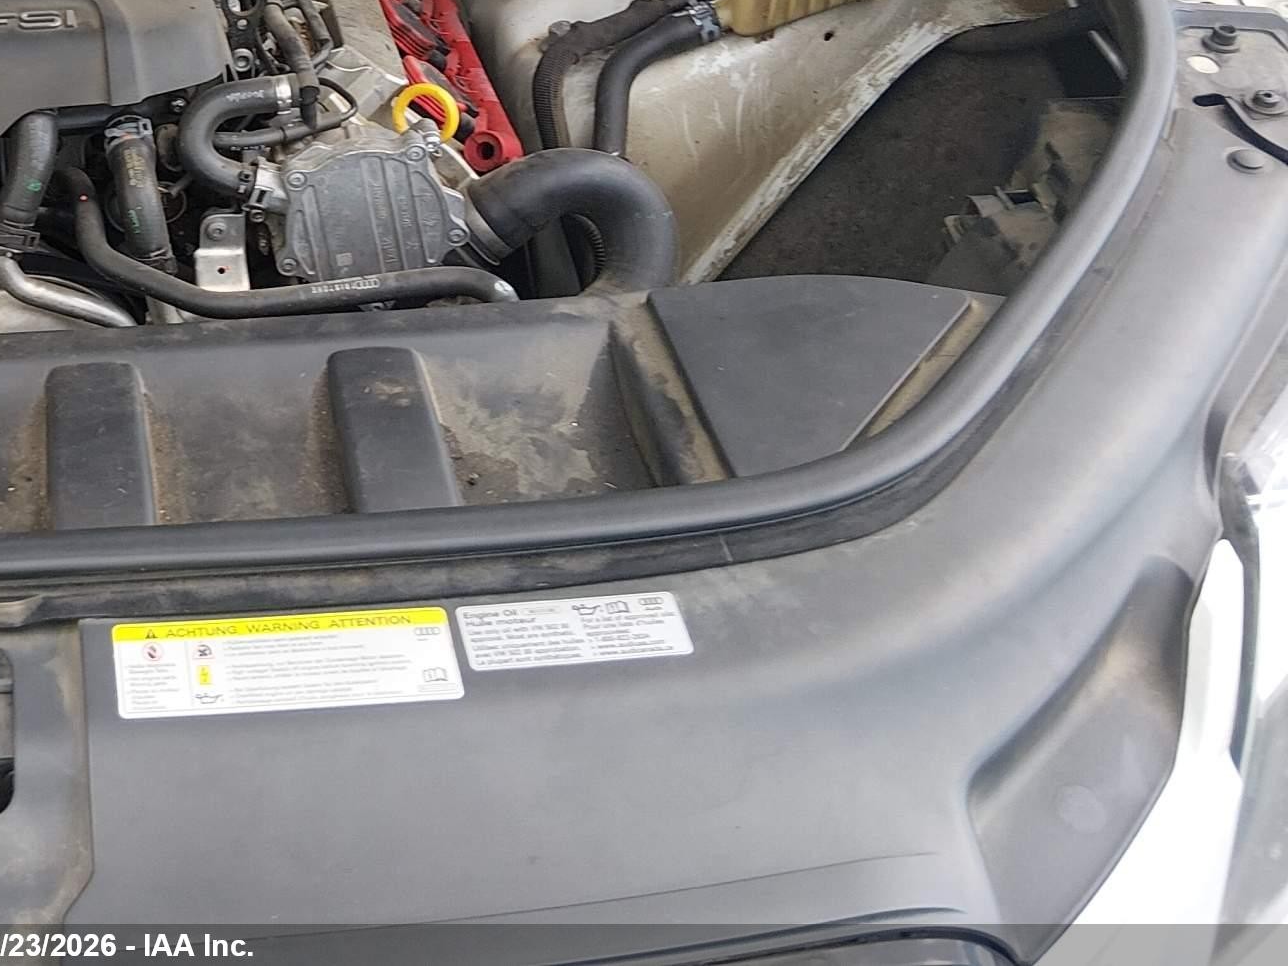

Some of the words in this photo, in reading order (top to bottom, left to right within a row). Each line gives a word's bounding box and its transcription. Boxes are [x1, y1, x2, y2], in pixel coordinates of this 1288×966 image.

[463, 611, 499, 620] Engine
[504, 609, 518, 617] Oil
[166, 624, 238, 639] ACHTUNG
[246, 620, 320, 634] WARNING
[328, 614, 411, 629] ATTENTION
[495, 617, 537, 625] moteur
